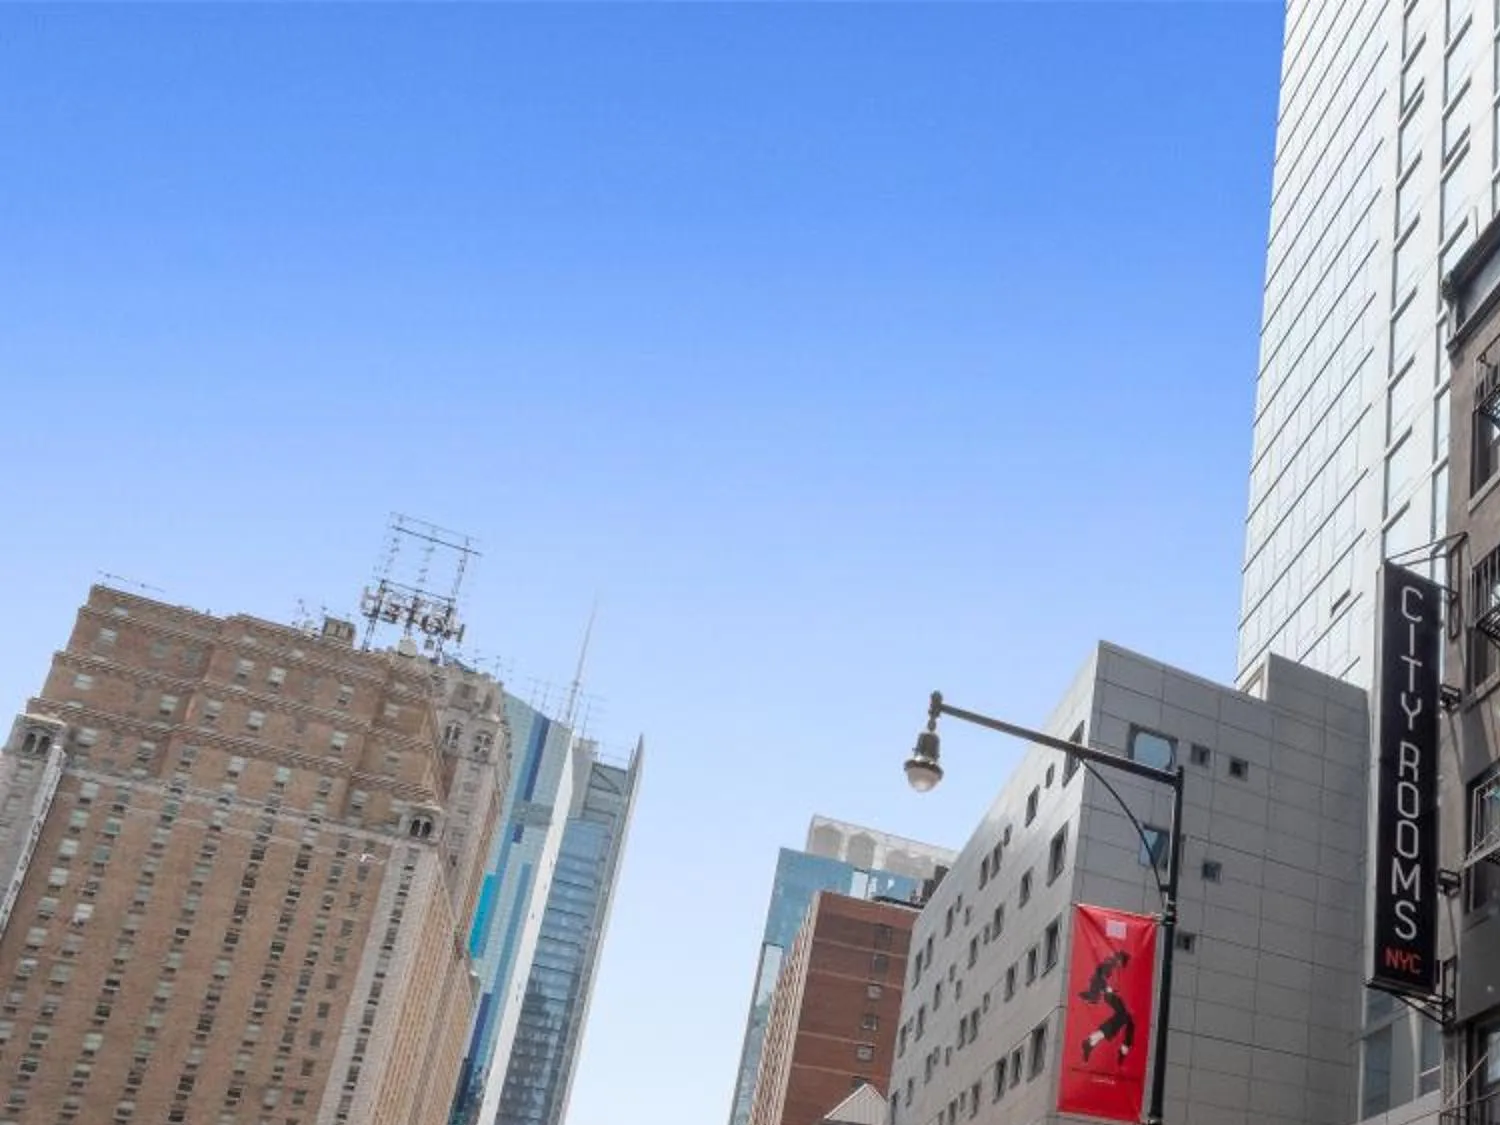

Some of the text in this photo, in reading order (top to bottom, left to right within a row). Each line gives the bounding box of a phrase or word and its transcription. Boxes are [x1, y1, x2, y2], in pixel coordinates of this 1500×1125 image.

[1400, 585, 1423, 731] CITY
[1391, 740, 1421, 942] ROOMS
[1385, 948, 1422, 975] NYC
